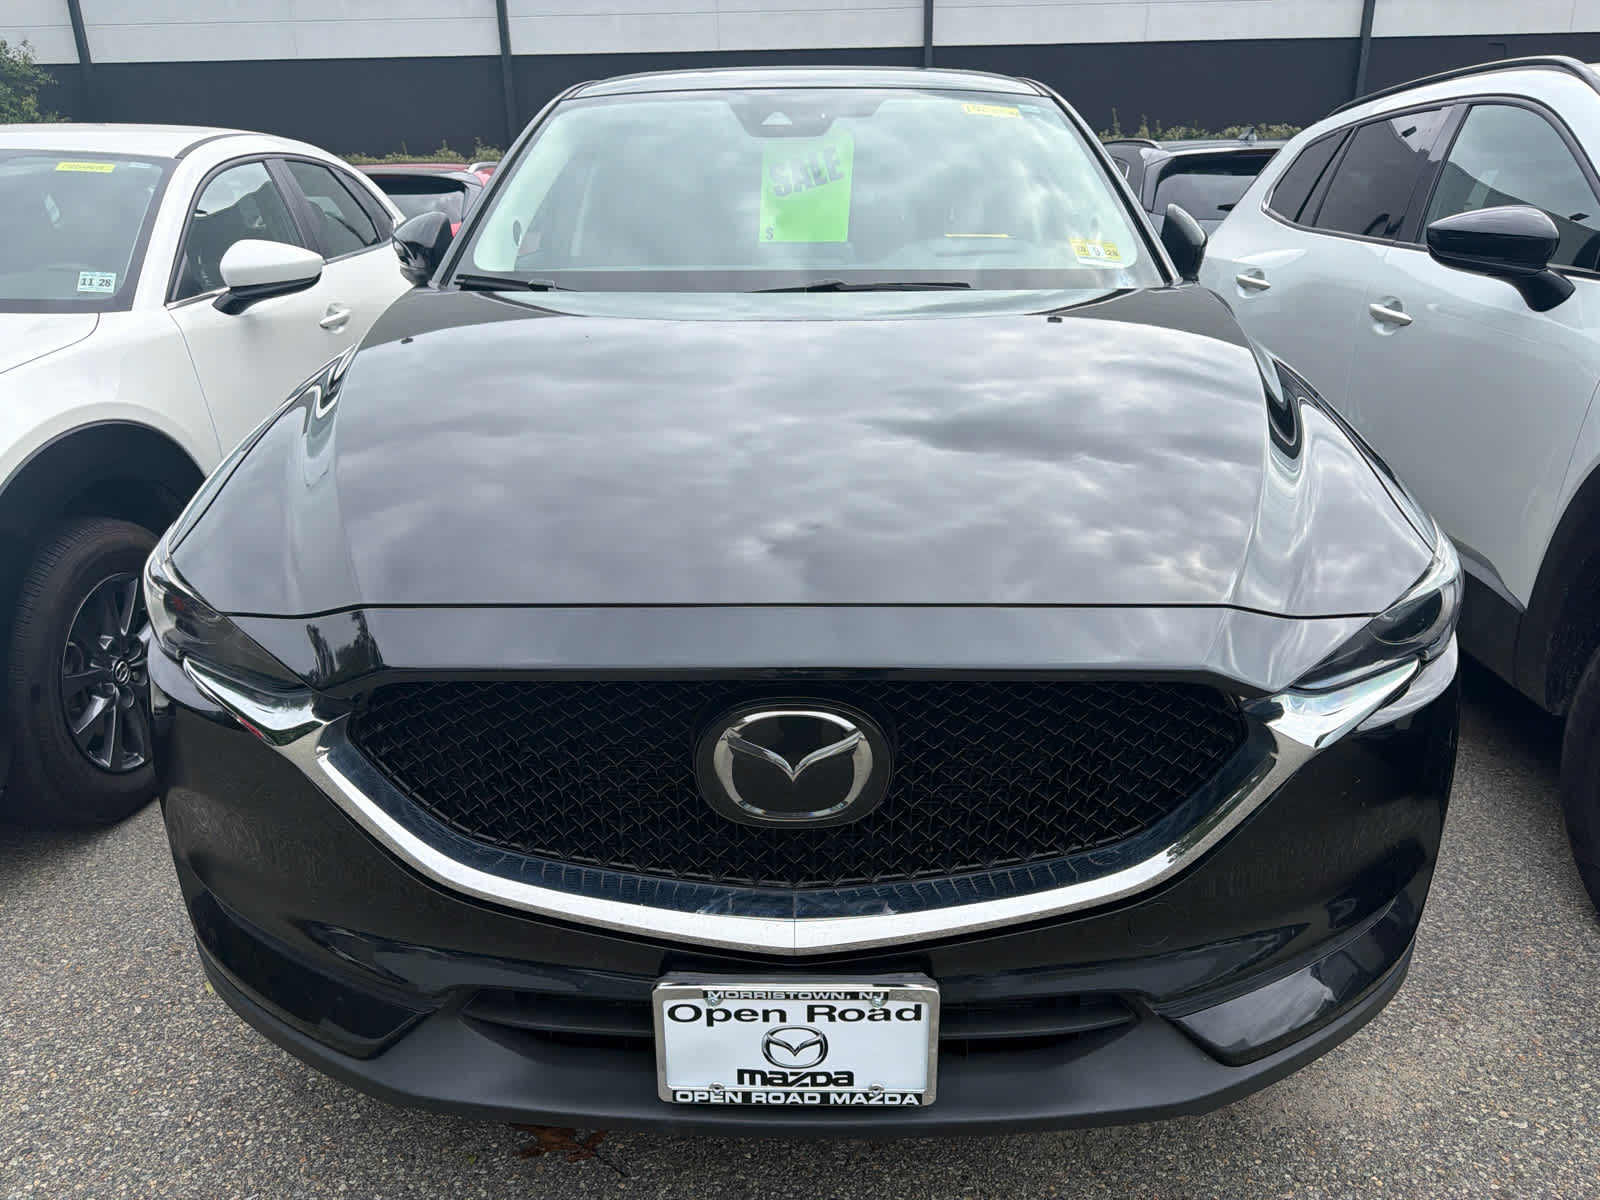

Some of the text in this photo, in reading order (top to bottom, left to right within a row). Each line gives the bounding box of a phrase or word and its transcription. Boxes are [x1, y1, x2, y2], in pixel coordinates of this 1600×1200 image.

[767, 143, 845, 198] SALE
[80, 278, 111, 288] 11 28
[667, 1003, 922, 1027] Open Road
[736, 1068, 855, 1088] mazda
[675, 1090, 920, 1105] OPEN ROAD MAZDA
